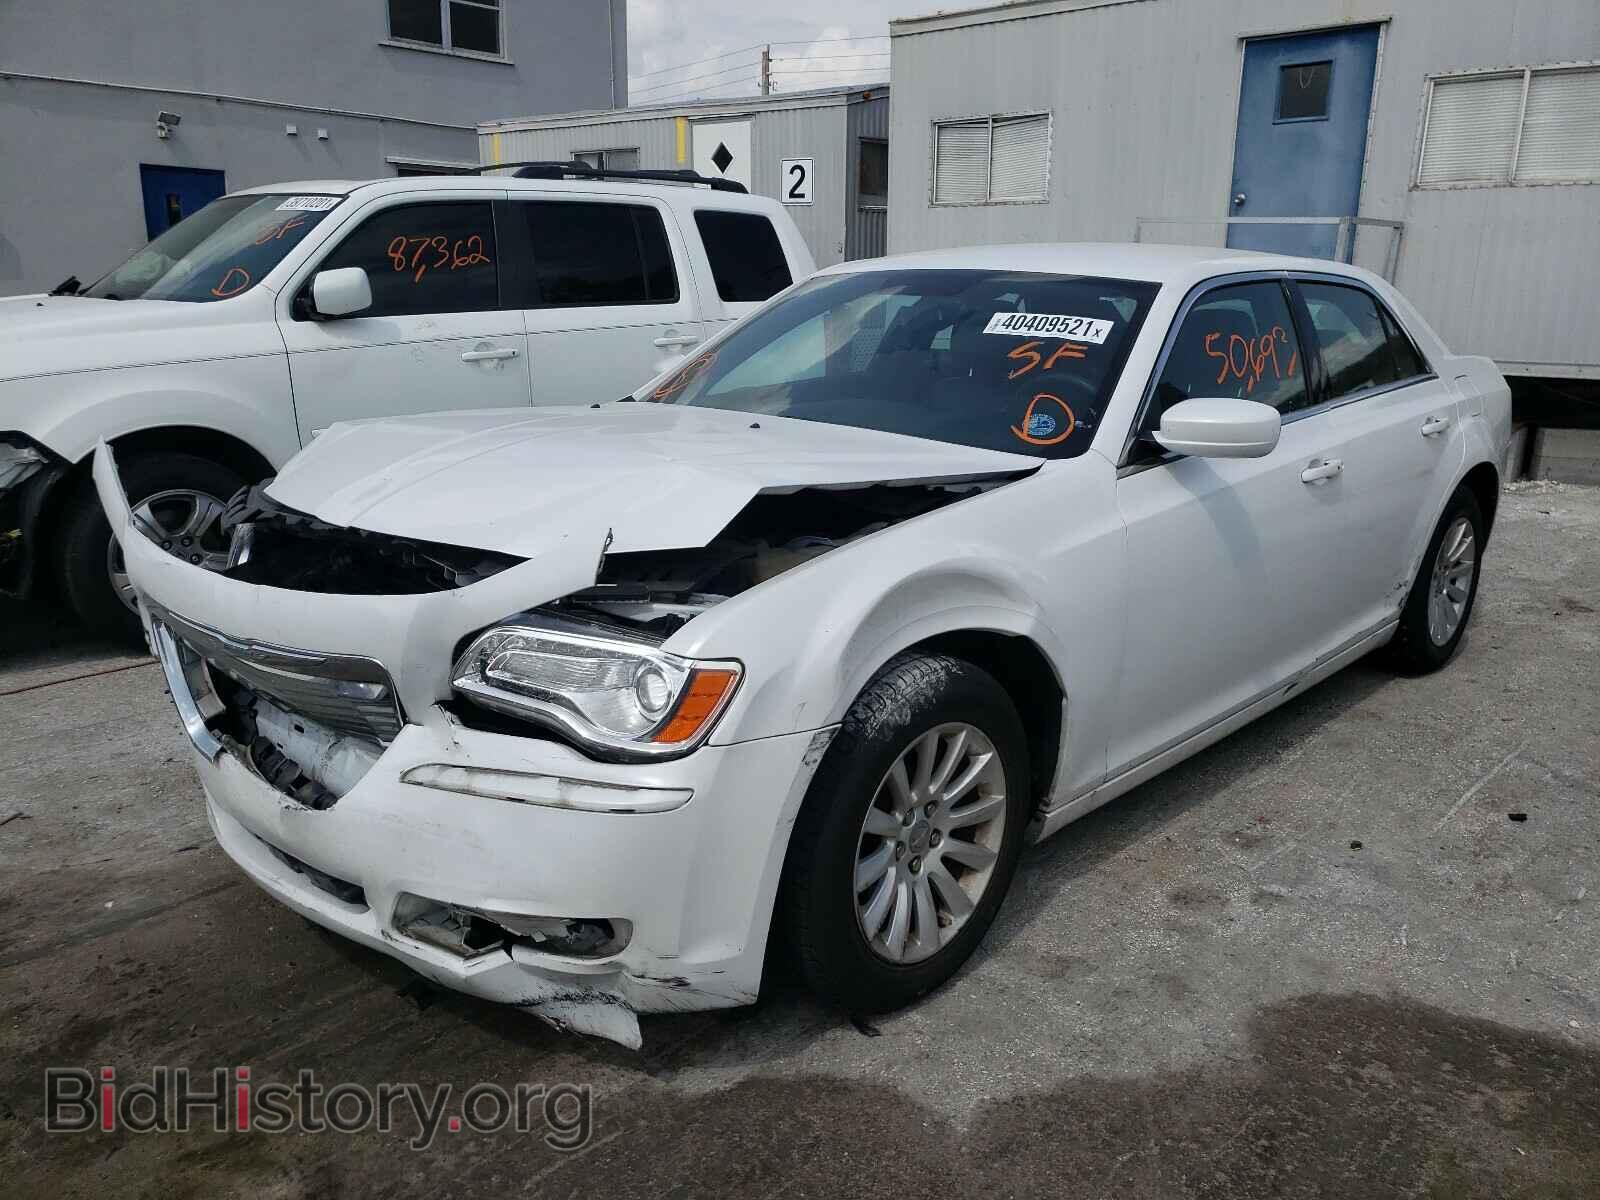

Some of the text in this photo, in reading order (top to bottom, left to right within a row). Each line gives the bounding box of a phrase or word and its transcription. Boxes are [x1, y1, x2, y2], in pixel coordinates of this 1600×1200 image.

[789, 164, 806, 199] 2
[387, 235, 491, 282] 87,362
[210, 266, 251, 297] D
